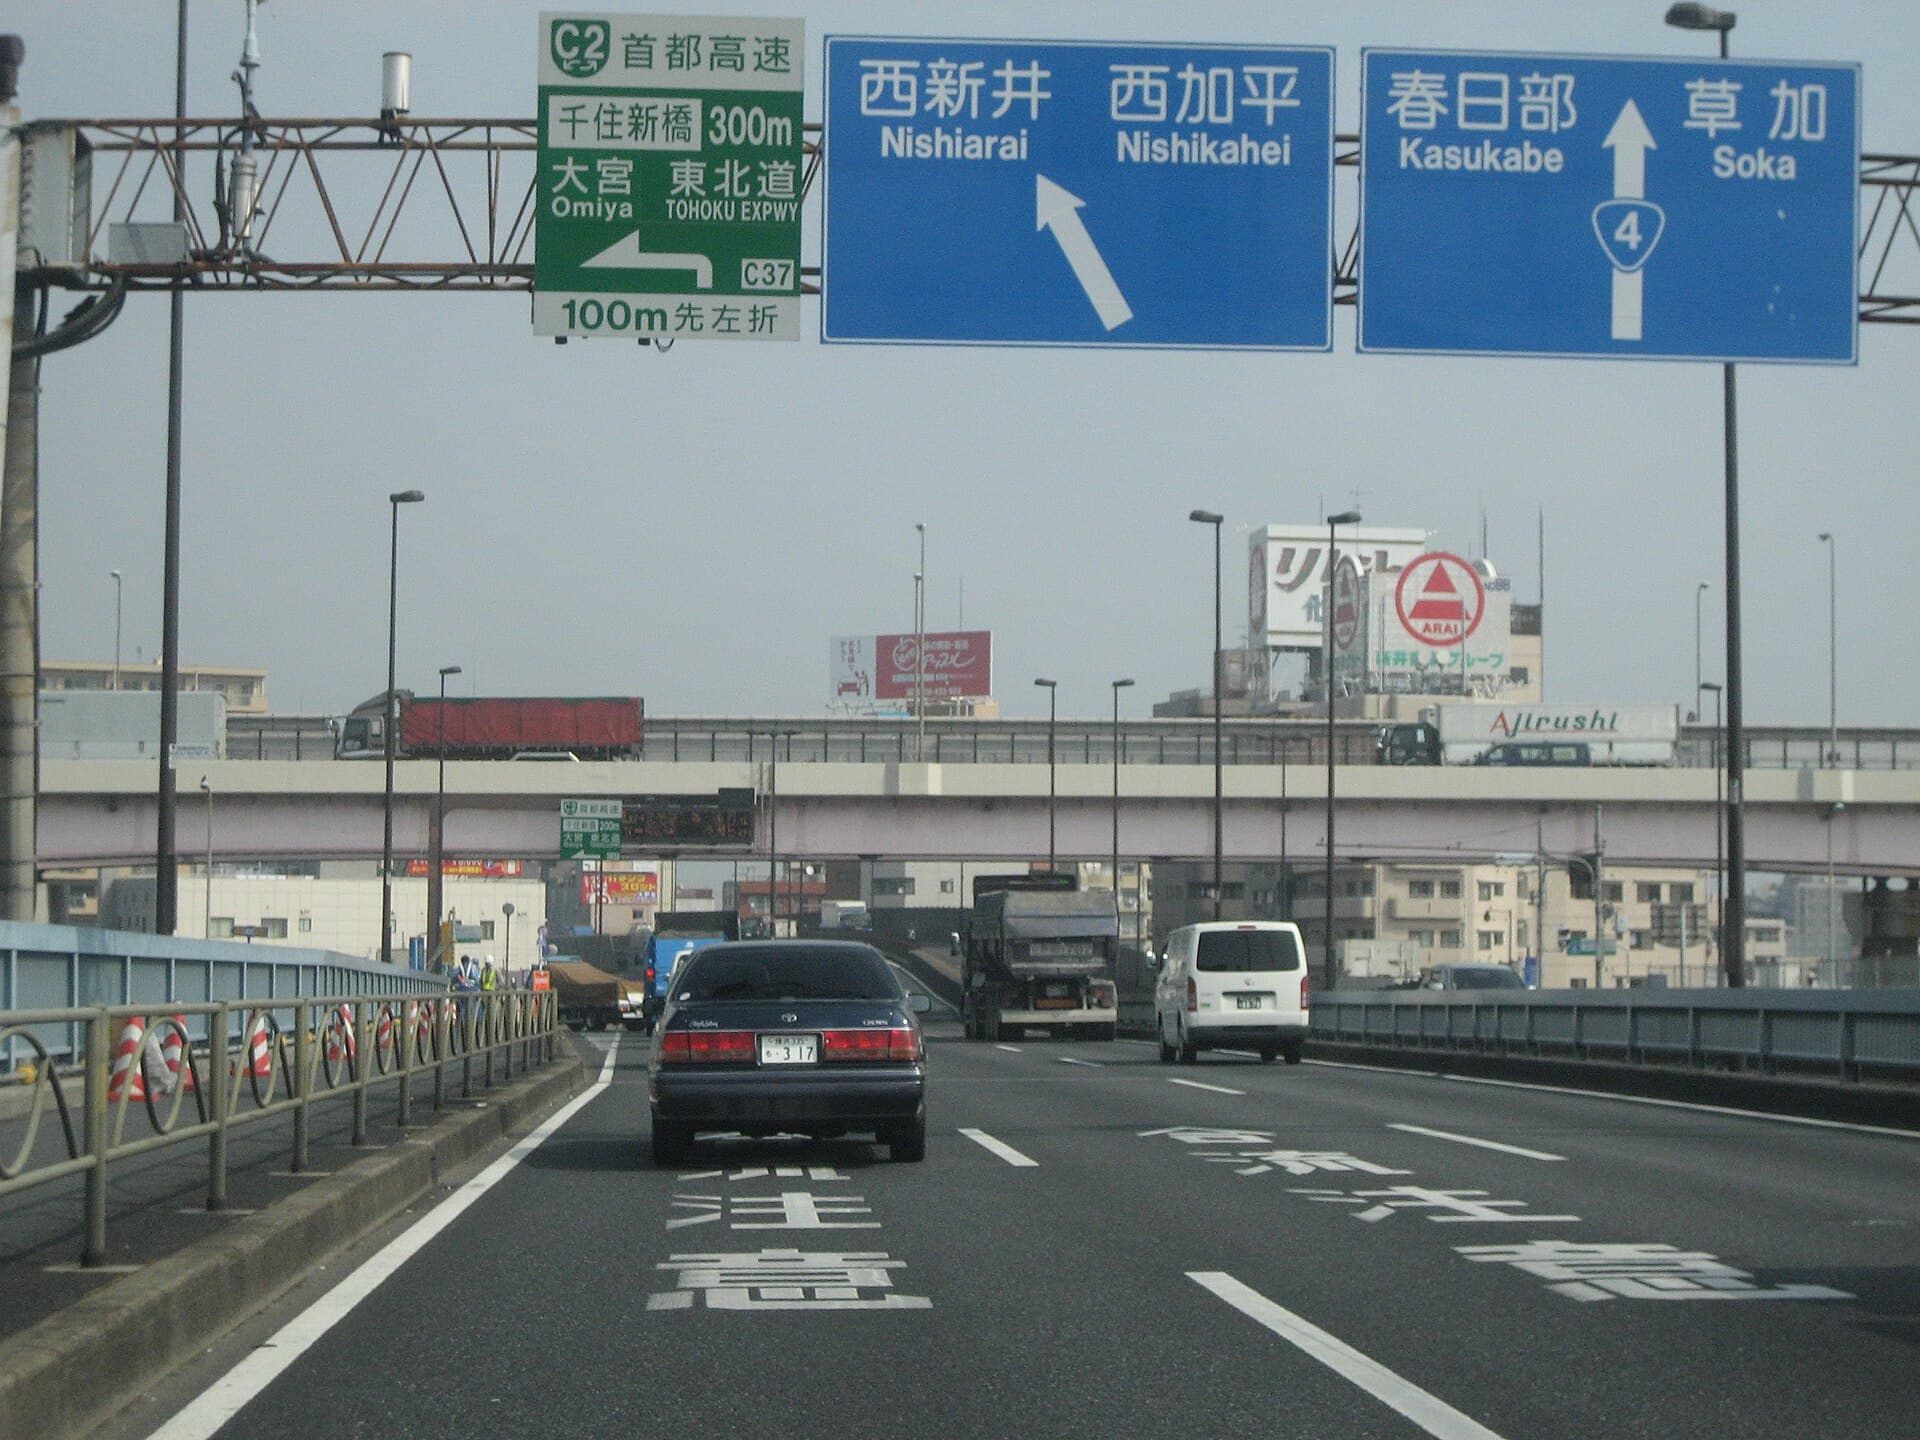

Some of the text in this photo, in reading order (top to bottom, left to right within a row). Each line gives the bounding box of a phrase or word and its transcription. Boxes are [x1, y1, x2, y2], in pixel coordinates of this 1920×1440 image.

[555, 23, 605, 61] C2
[621, 33, 791, 73] 首都高速
[859, 57, 1052, 120] 西新井
[1110, 62, 1301, 126] 西加平
[1386, 69, 1578, 135] 春日部
[559, 102, 793, 146] 千住新橋 300m
[1684, 78, 1827, 142] 草加
[880, 126, 1028, 161] Nishiarai
[1117, 131, 1292, 166] Nishikahei
[1400, 137, 1564, 173] Kasukabe
[551, 156, 797, 199] 大宮 東北道
[1713, 145, 1797, 181] Soka
[551, 196, 634, 222] Omiya
[666, 199, 799, 223] TOHOKU EXPWY
[1613, 211, 1643, 250] 4
[744, 262, 792, 287] C37
[561, 299, 779, 334] 100m先左折
[1422, 622, 1459, 634] ARAI
